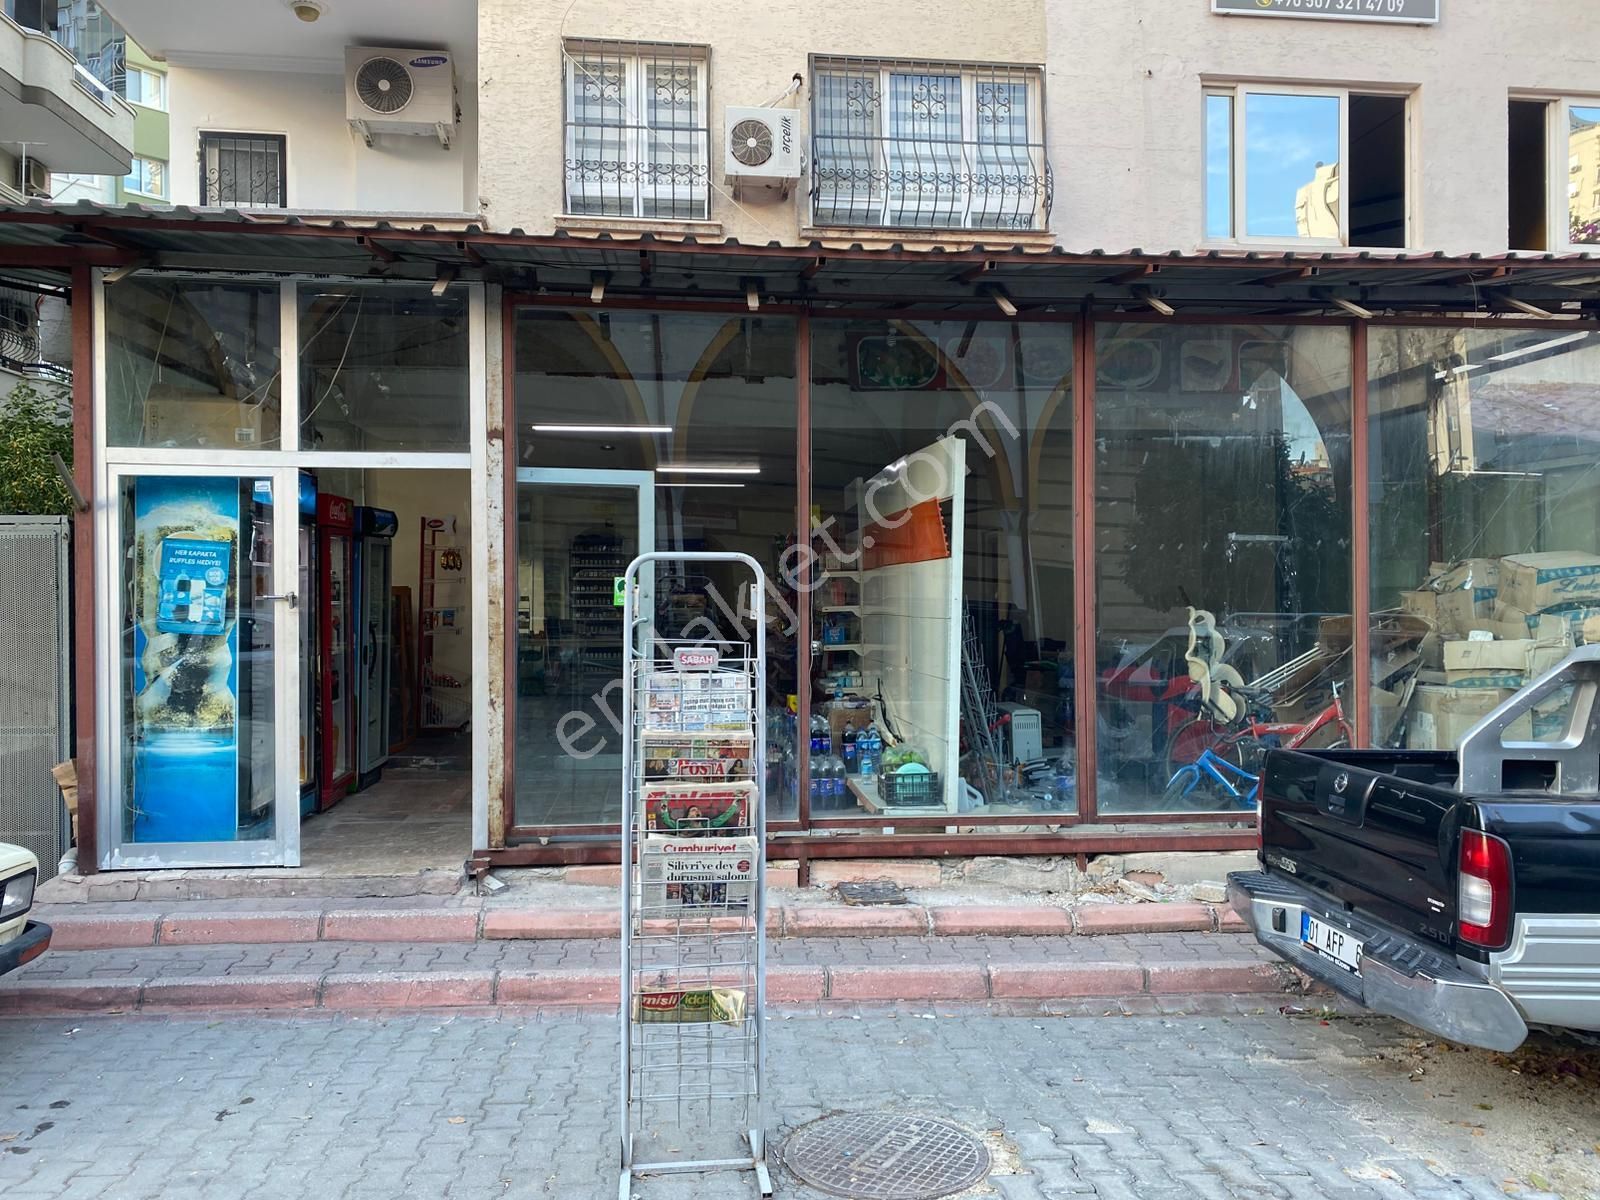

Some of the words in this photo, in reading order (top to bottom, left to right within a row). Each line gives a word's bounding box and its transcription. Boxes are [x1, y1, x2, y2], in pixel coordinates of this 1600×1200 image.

[1388, 0, 1405, 12] 09
[781, 116, 793, 154] arçelik
[190, 550, 217, 558] KAPAKTA
[169, 557, 195, 565] RUFFLES
[681, 655, 714, 665] SABAH
[1308, 920, 1319, 945] 01
[1326, 930, 1345, 957] AFP
[643, 994, 677, 1006] misli
